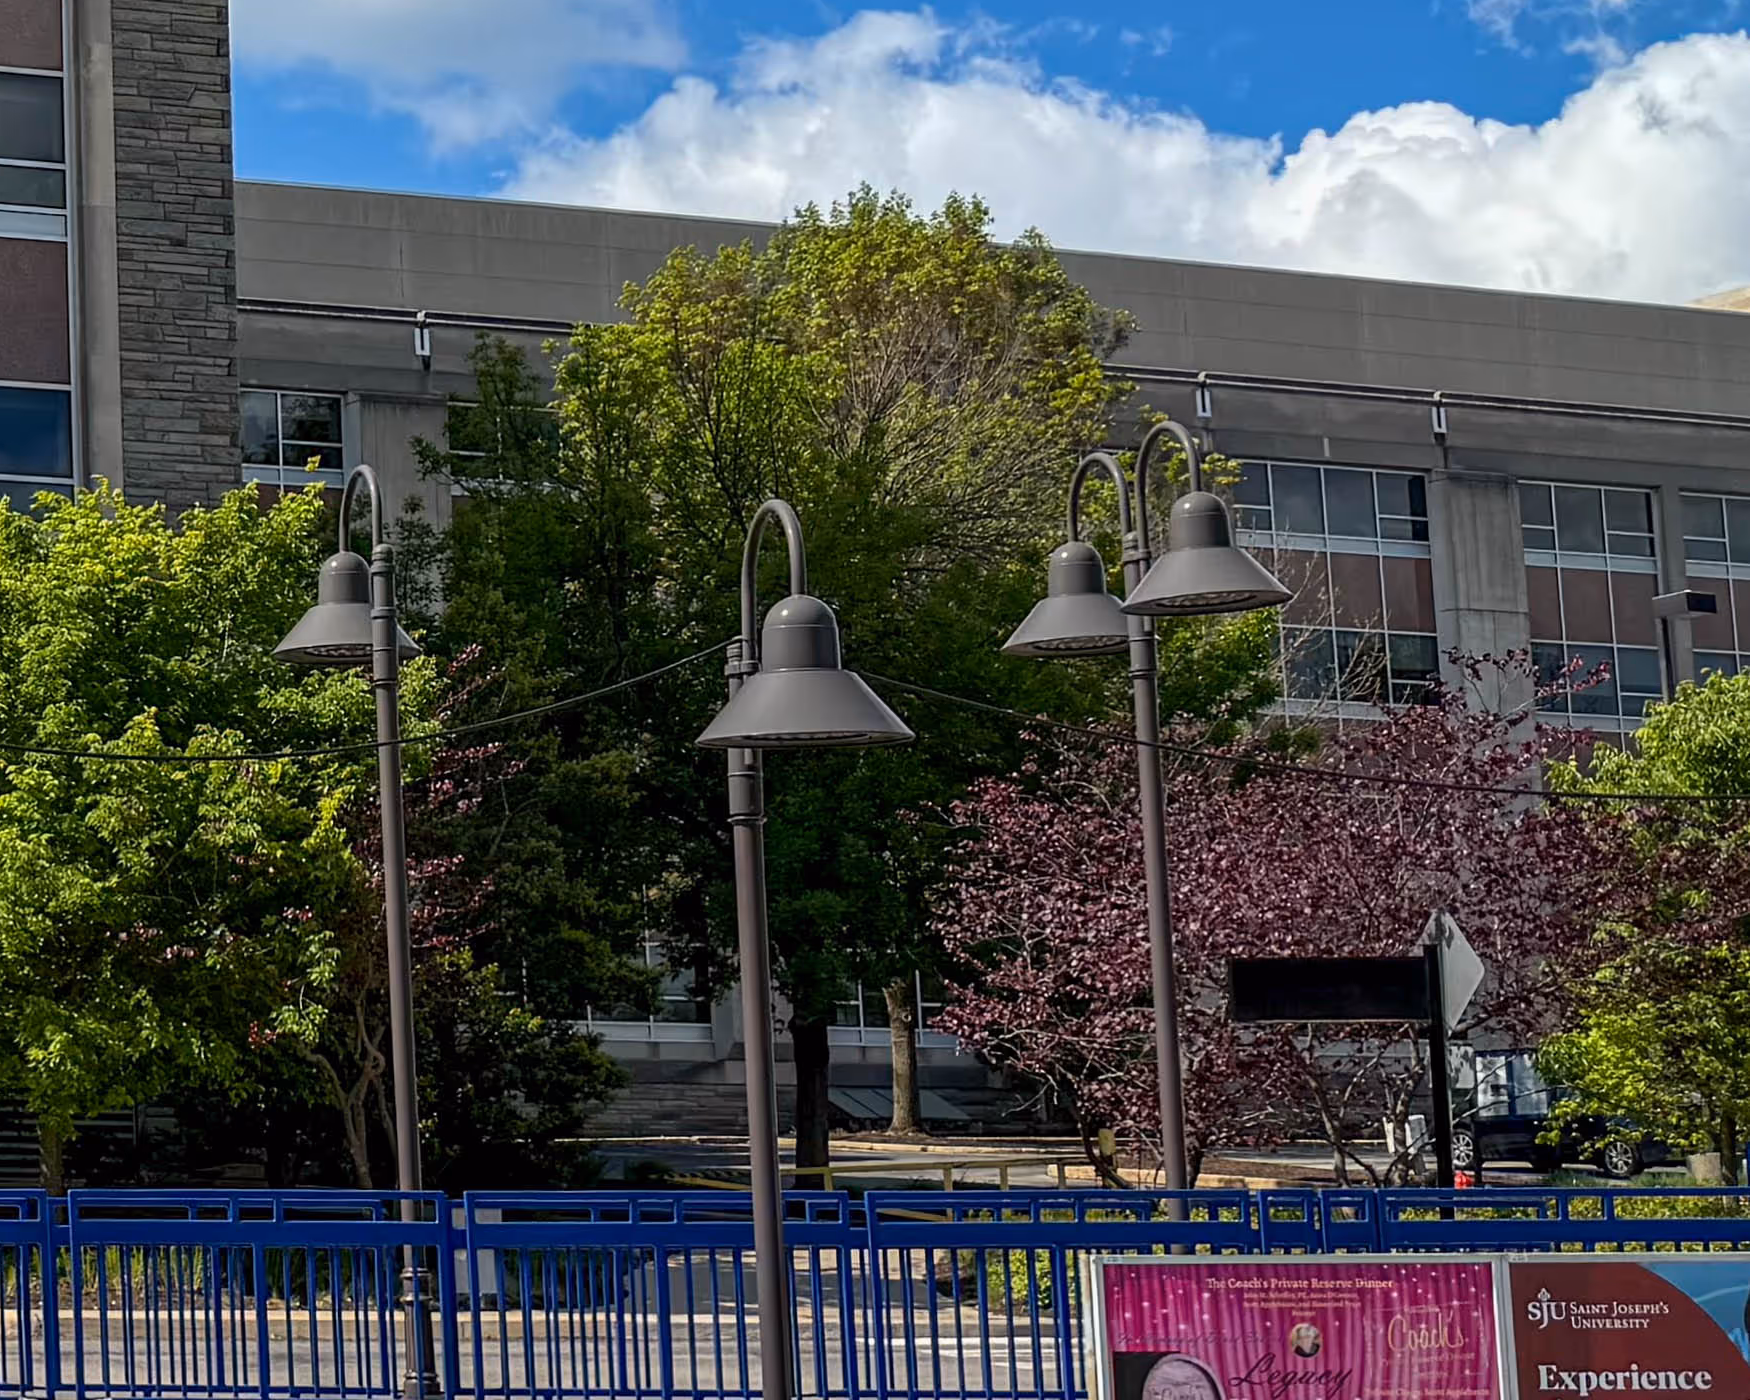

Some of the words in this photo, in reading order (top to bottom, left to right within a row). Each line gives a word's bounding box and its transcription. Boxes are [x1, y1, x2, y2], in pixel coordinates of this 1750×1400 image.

[1205, 1277, 1226, 1290] The
[1227, 1277, 1269, 1290] Coach's
[1270, 1278, 1310, 1290] Private
[1311, 1278, 1353, 1290] Reserve
[1355, 1278, 1394, 1290] Dinner
[1527, 1301, 1567, 1330] SJU
[1569, 1301, 1609, 1315] SAINT
[1611, 1301, 1671, 1317] JOSEPH'S
[1570, 1315, 1651, 1329] UNIVERSITY
[1387, 1309, 1466, 1350] Coach's
[1228, 1352, 1353, 1399] Legacy
[1537, 1362, 1713, 1397] Experience
